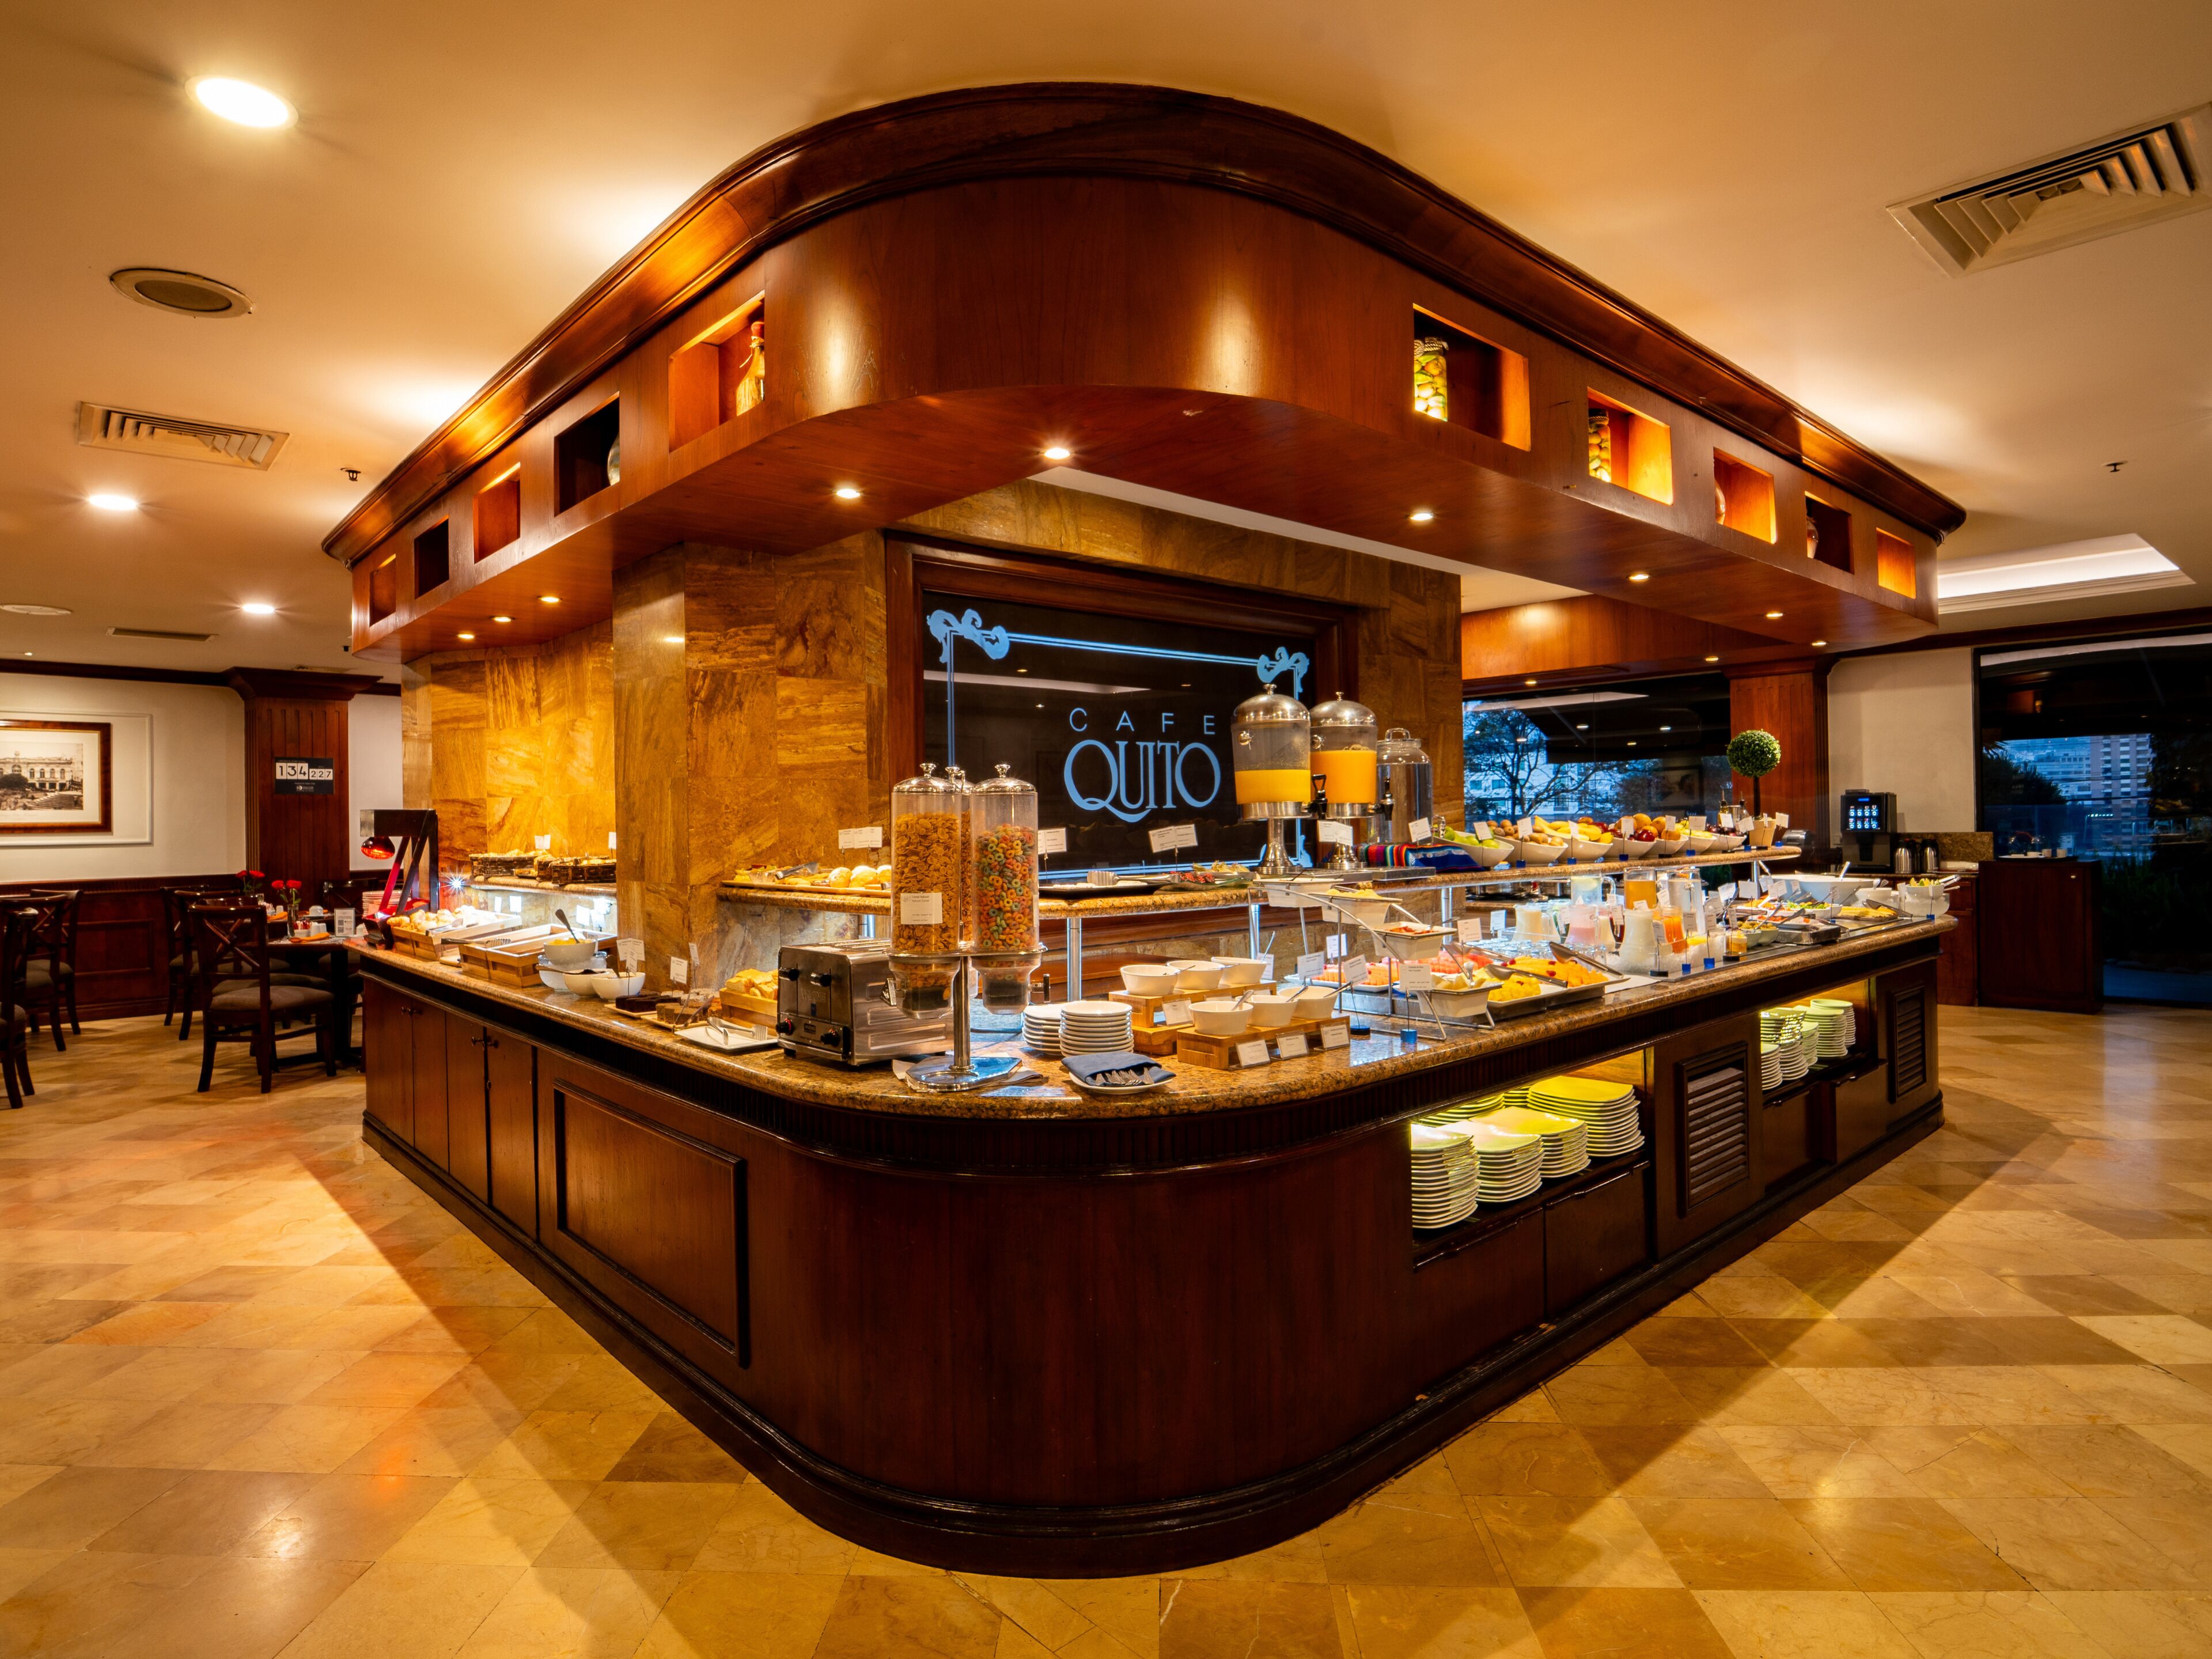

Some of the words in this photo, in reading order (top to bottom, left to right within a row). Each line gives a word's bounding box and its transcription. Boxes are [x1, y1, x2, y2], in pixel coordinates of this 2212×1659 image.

[1069, 707, 1215, 735] CAFE
[279, 765, 307, 777] 134
[310, 770, 332, 778] 227
[1064, 739, 1221, 823] QUITO
